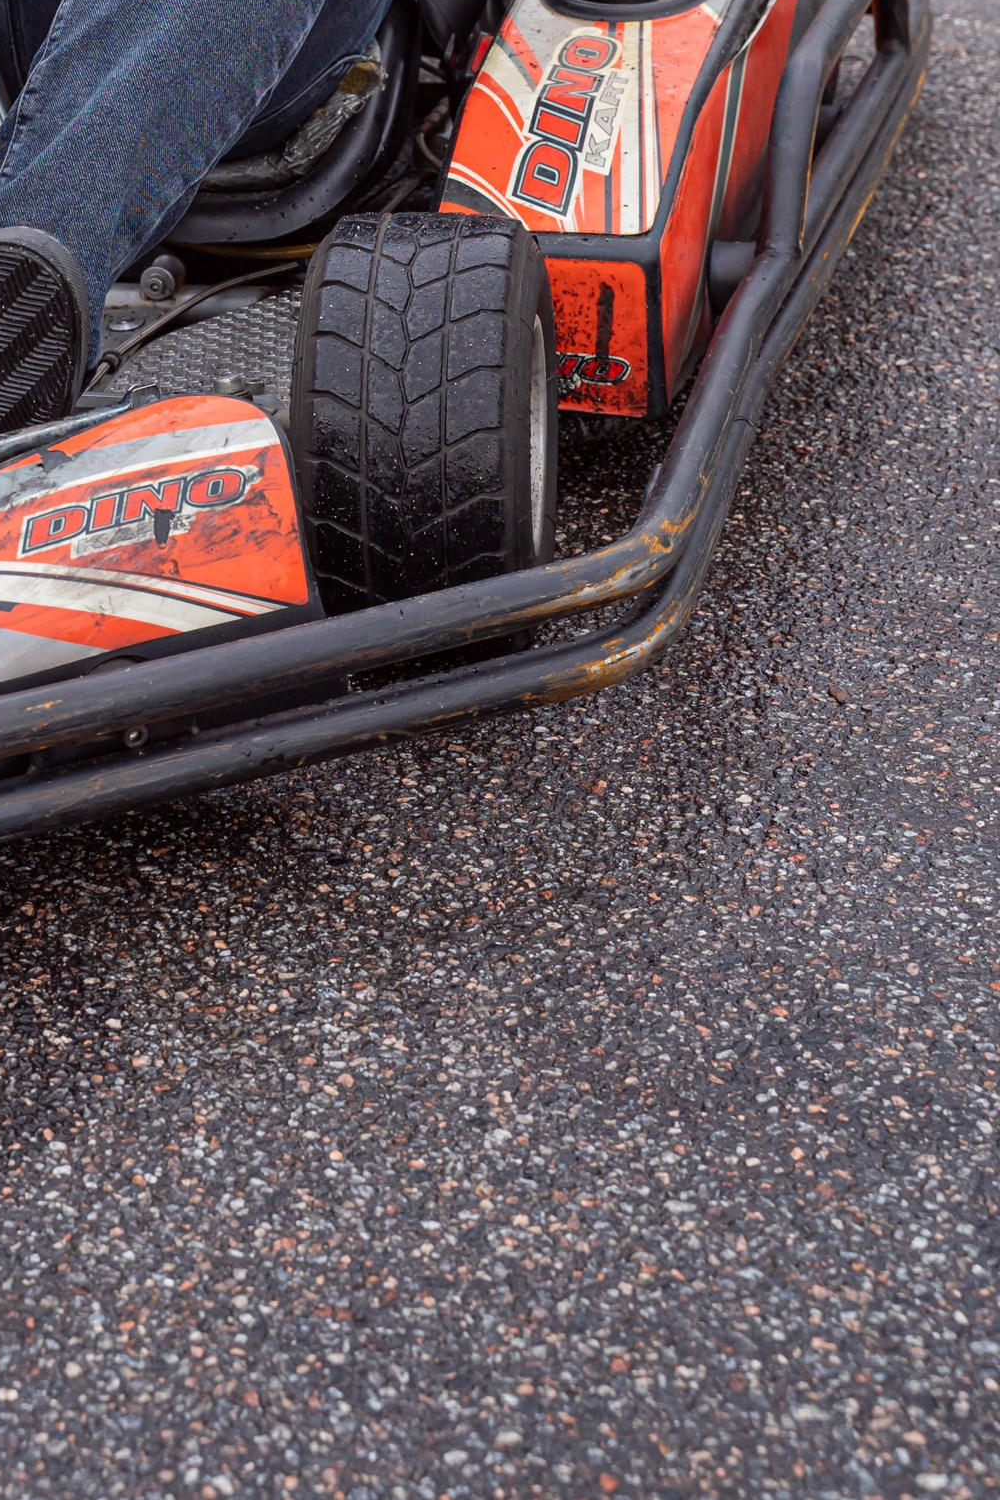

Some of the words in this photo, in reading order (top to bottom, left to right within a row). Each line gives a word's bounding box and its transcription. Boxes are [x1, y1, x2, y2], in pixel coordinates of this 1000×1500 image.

[511, 35, 620, 218] DINO
[584, 70, 629, 168] KART
[21, 467, 248, 555] DINO
